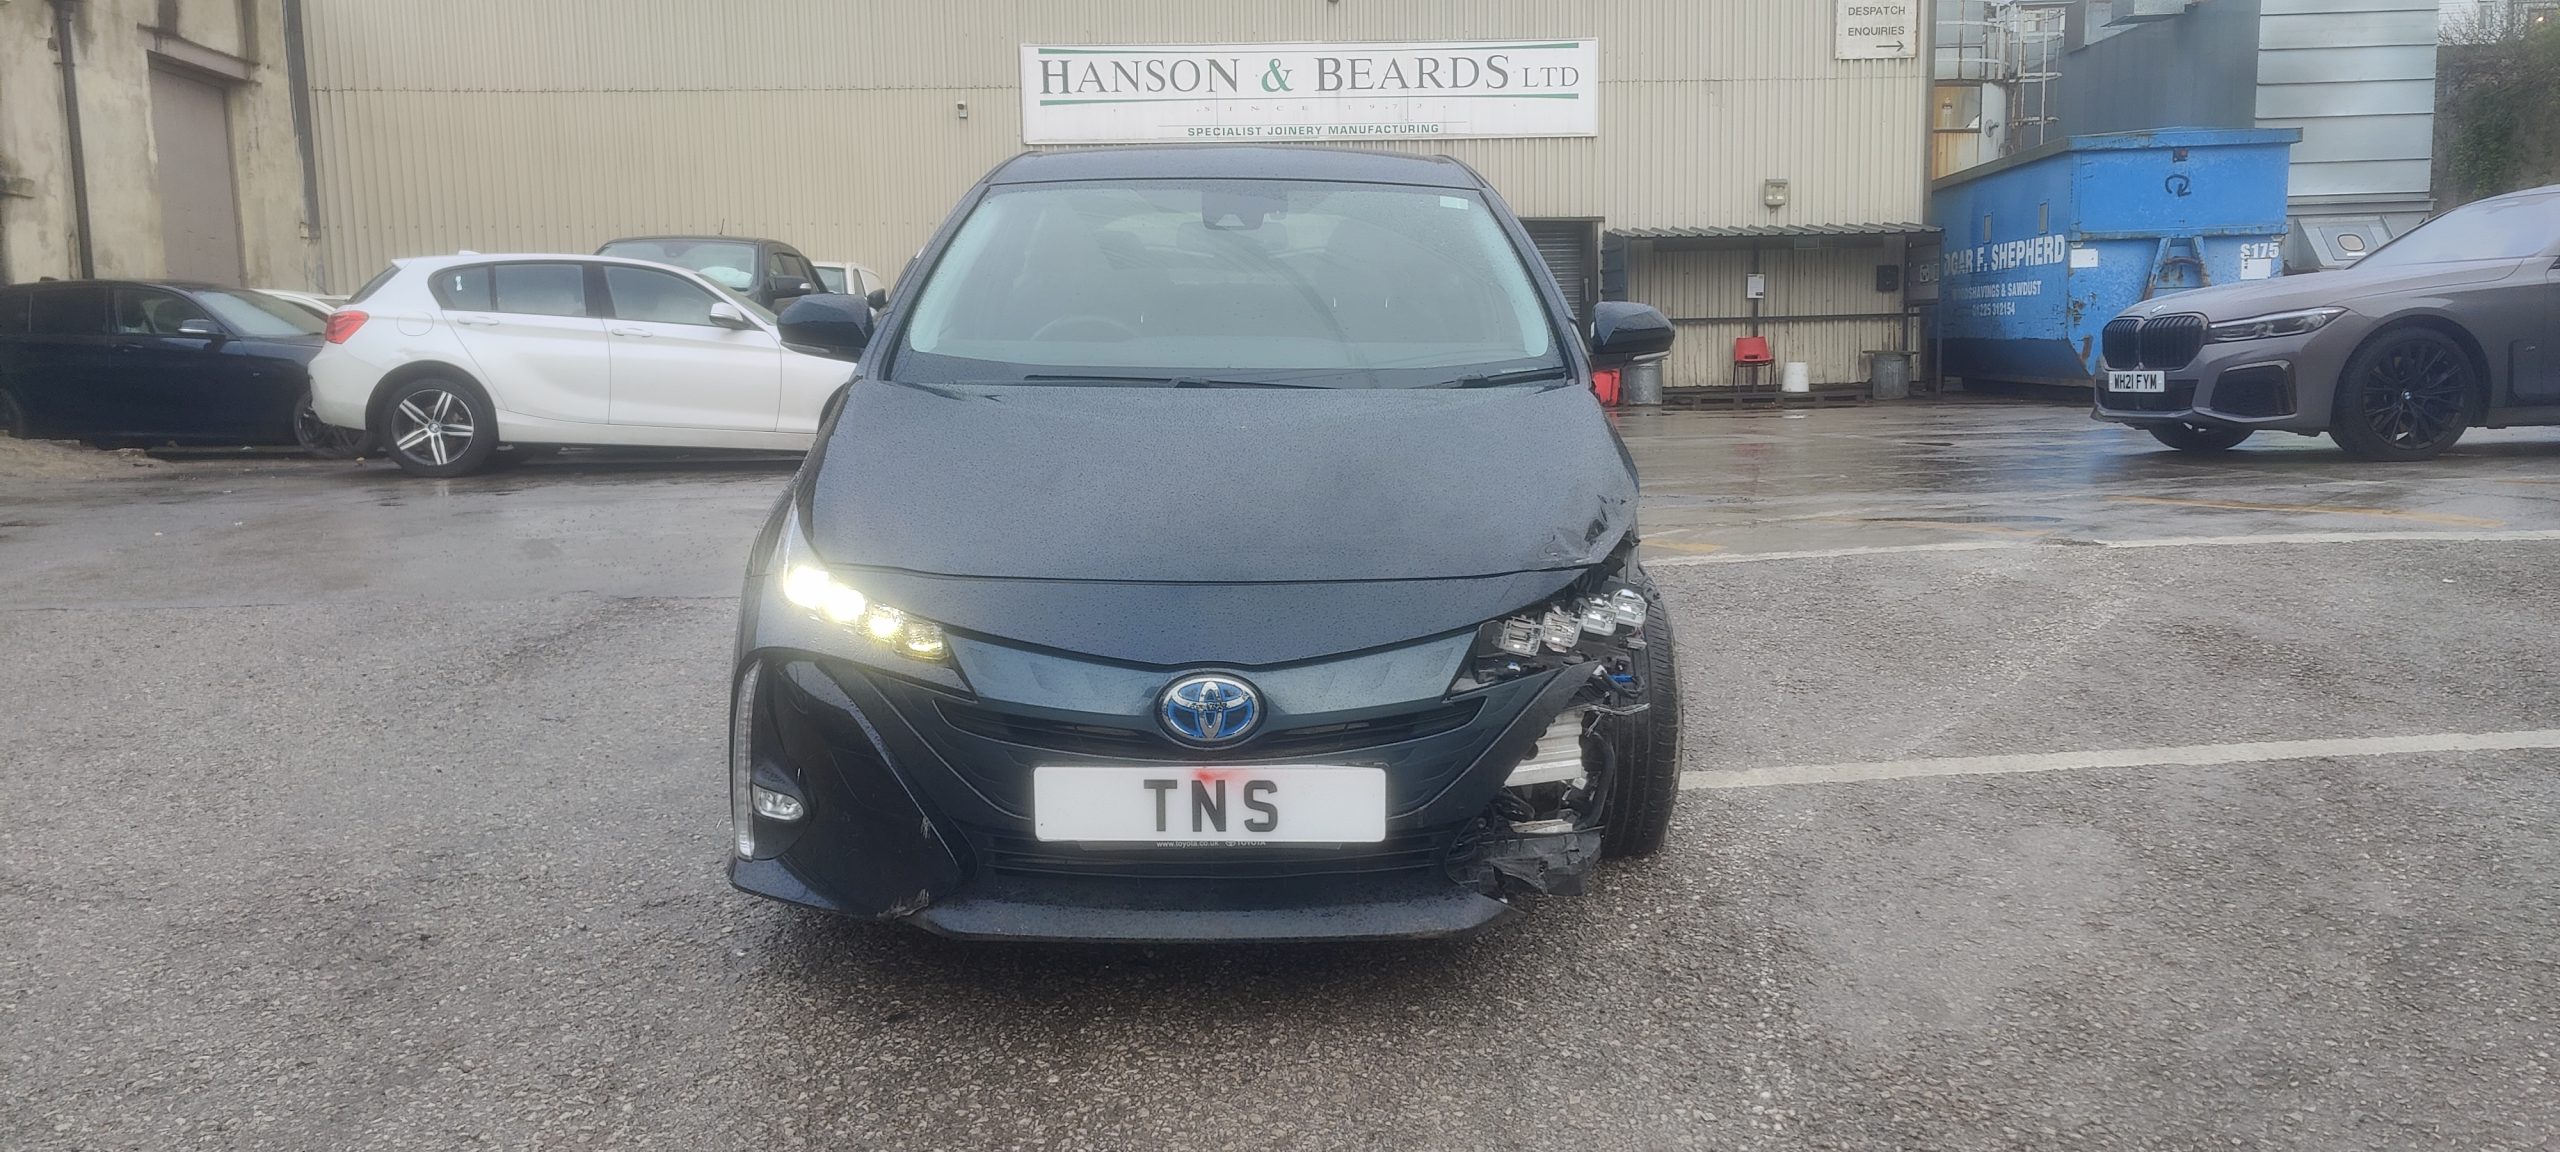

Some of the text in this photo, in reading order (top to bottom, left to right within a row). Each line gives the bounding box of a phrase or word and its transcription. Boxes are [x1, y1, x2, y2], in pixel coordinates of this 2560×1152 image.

[1848, 6, 1906, 16] DESPATCH
[1848, 26, 1905, 36] ENQUIRIES
[1039, 55, 1579, 95] HANSON & BEARDS LTD
[1187, 124, 1439, 137] SPECIALIST JOINERY MANUFACTURING
[1976, 246, 1988, 272] F.
[1991, 234, 2066, 271] SHEPHERD
[2240, 242, 2280, 259] S175
[2007, 281, 2042, 297] SAWDUST
[2114, 373, 2157, 389] WH21 FYM
[1143, 779, 1279, 833] TNS
